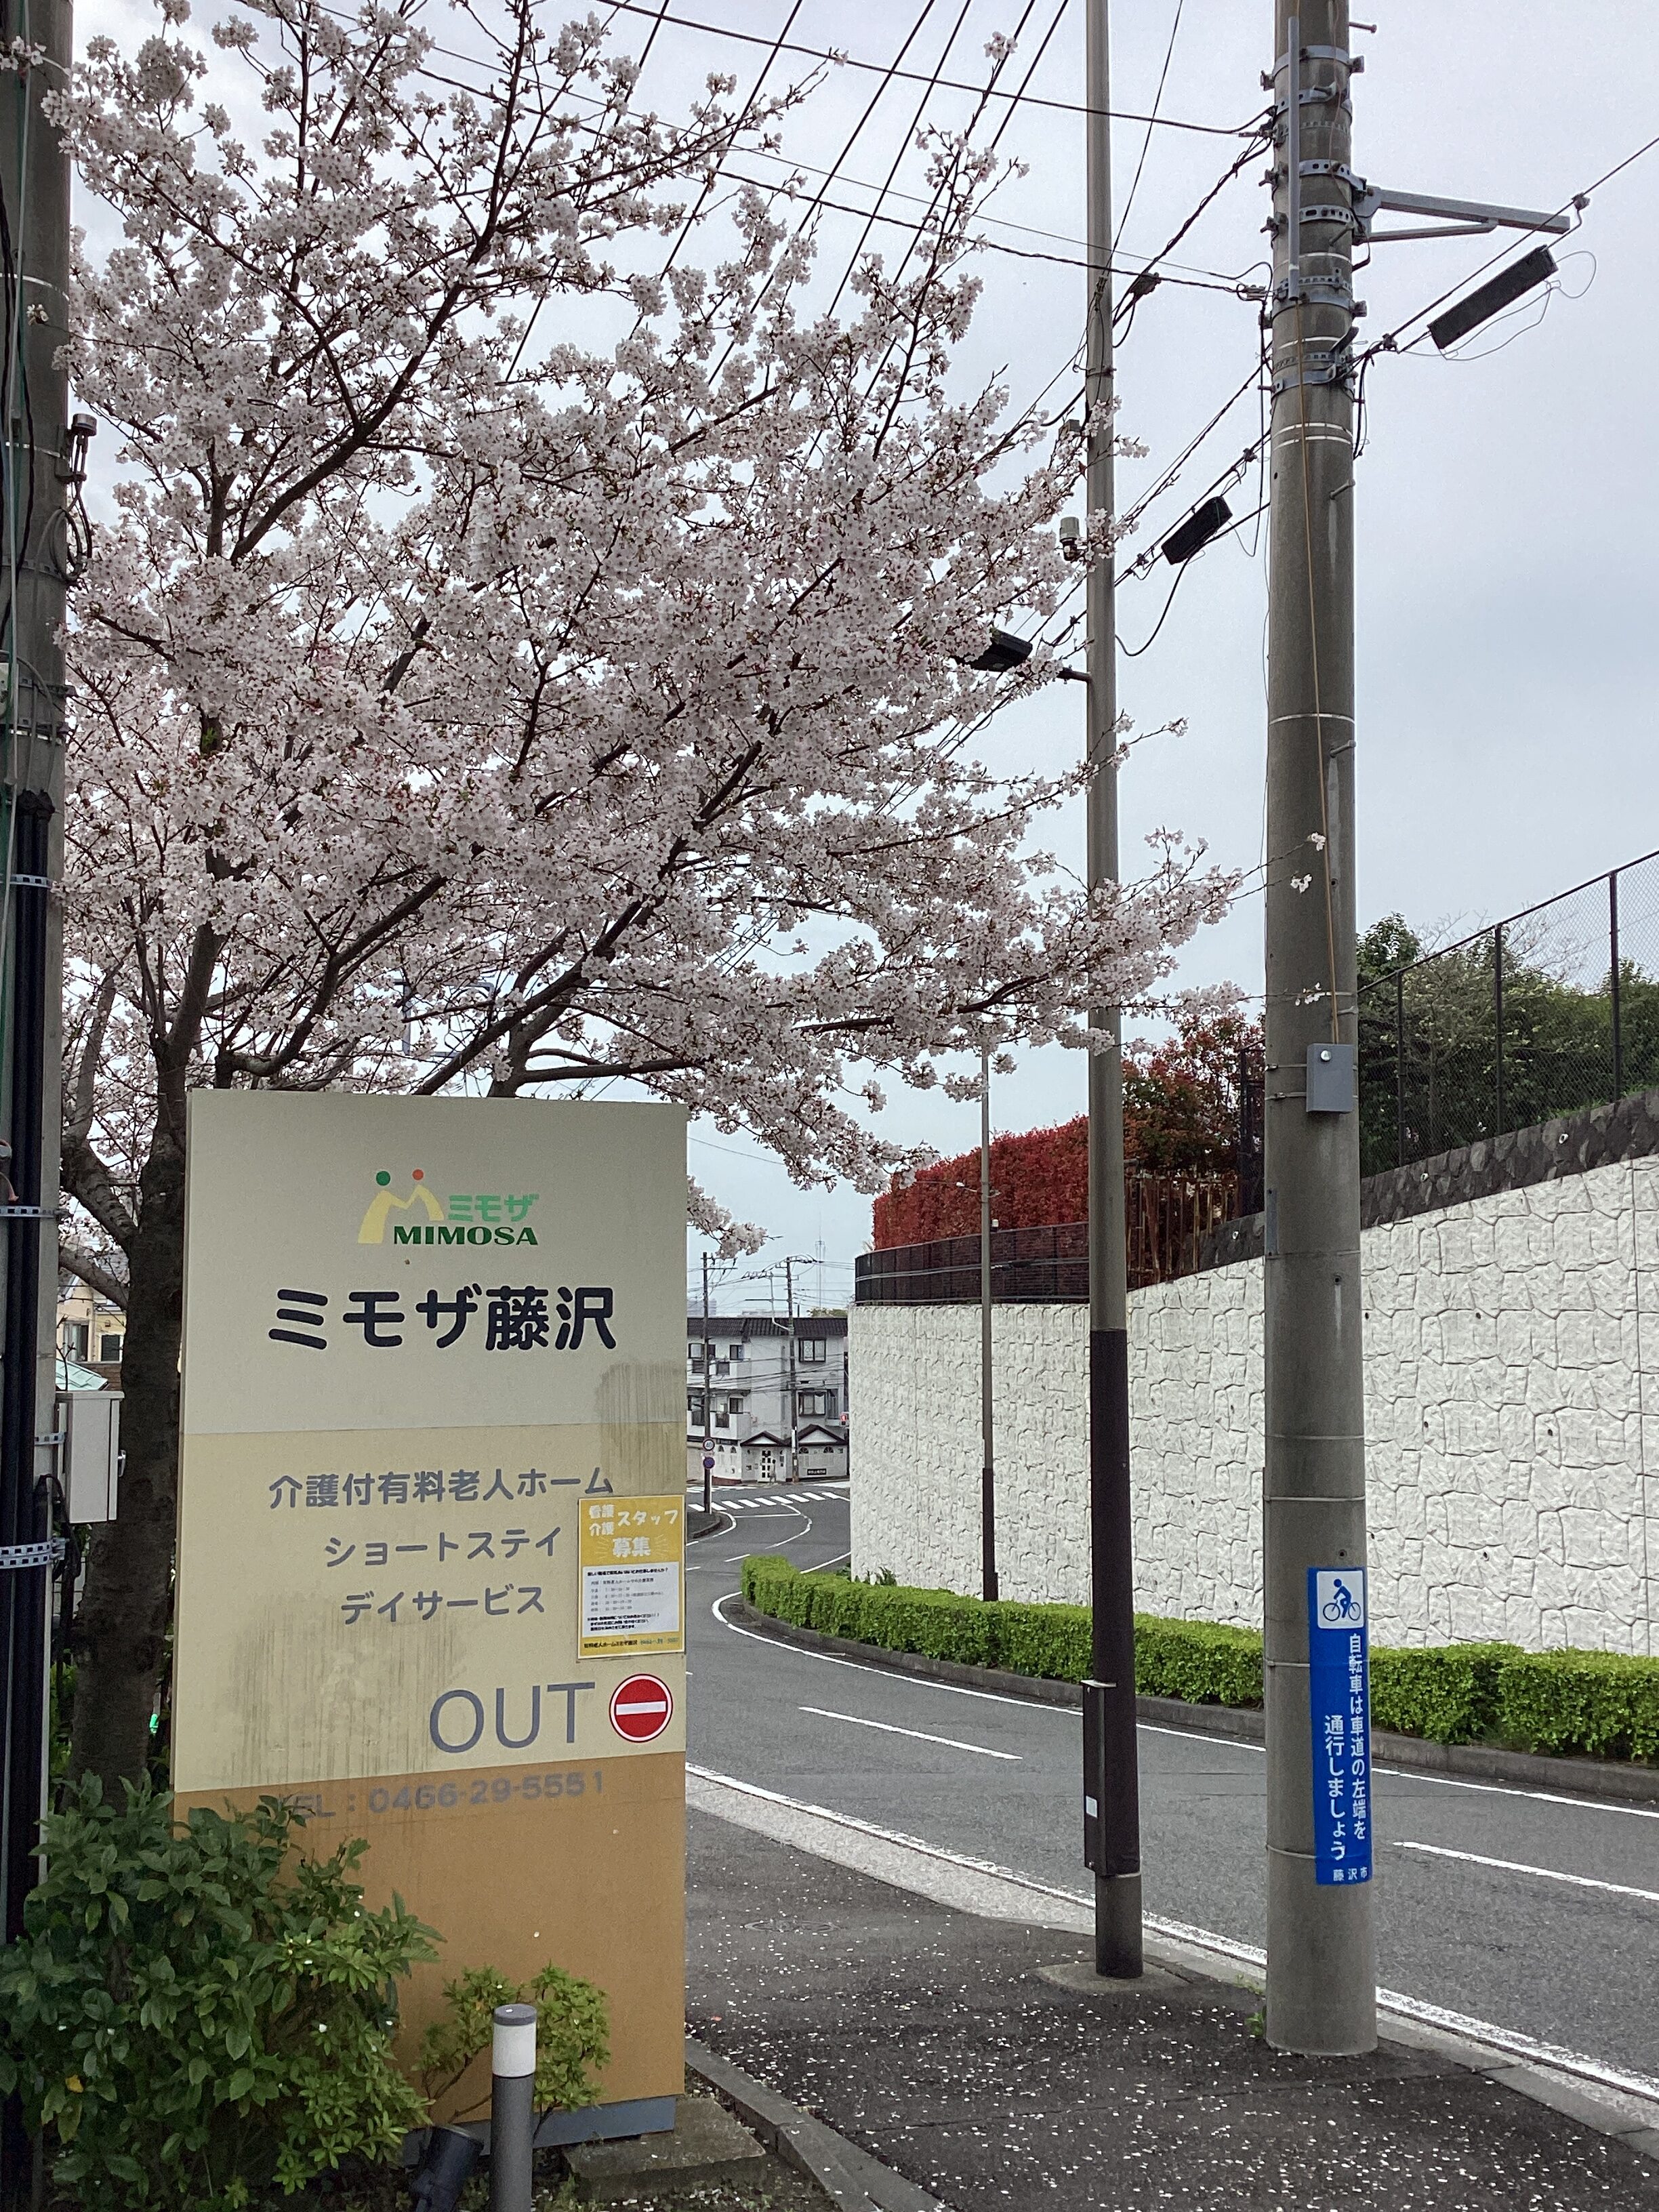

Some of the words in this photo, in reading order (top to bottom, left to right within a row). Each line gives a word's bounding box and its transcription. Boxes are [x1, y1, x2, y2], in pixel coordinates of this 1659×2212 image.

[447, 1193, 539, 1223] ミモザ
[394, 1226, 539, 1246] MIMOSA
[268, 1283, 617, 1351] ミモザ藤沢
[268, 1467, 614, 1509] 介護付有料老人ホーム
[589, 1521, 614, 1536] 介護
[617, 1509, 678, 1526] スタッフ
[325, 1526, 562, 1568] ショートステイ
[612, 1536, 651, 1557] 募集
[341, 1584, 545, 1624] デイサービス
[430, 1682, 595, 1753] OUT
[1349, 1633, 1366, 1840] 自転車は車道の左端を
[1324, 1715, 1346, 1861] 通行しましょう
[1333, 1866, 1368, 1882] 藤沢市
